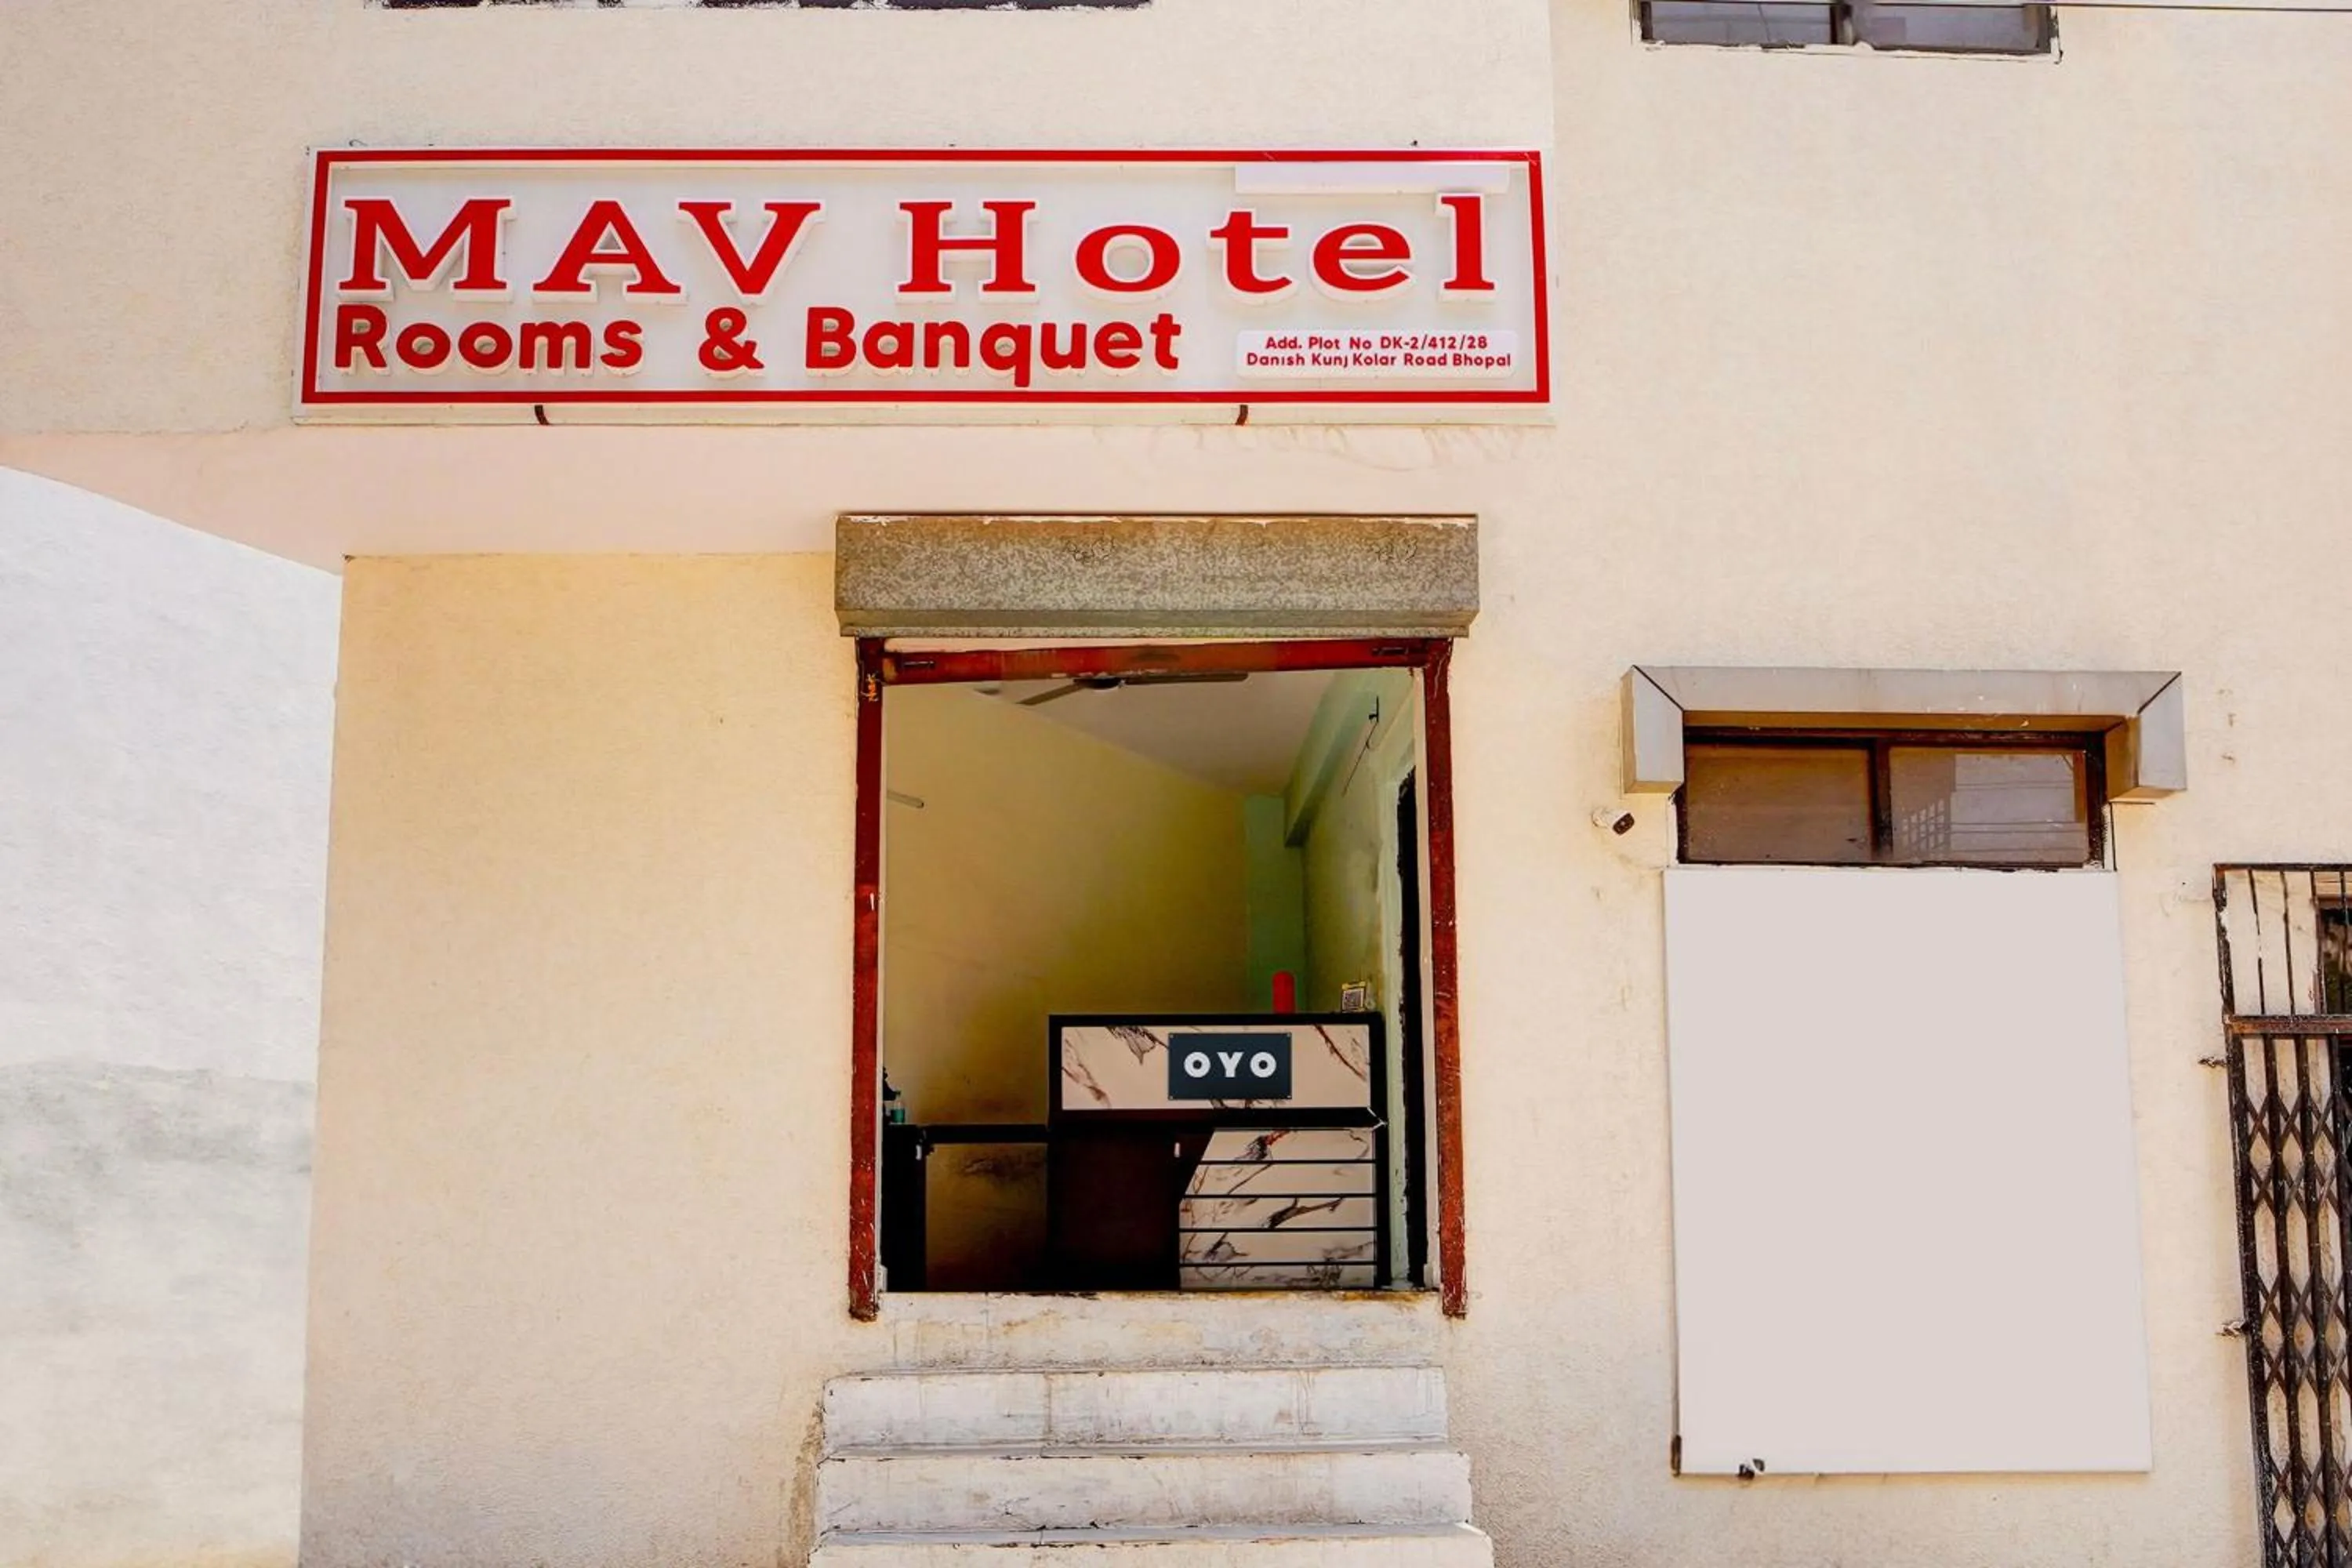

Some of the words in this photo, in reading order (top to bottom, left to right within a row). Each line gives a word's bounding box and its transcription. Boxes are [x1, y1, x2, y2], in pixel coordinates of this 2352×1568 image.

[338, 198, 822, 295] MAV
[898, 195, 1495, 294] Hotel
[334, 303, 644, 369] Rooms
[698, 307, 765, 371] &
[806, 307, 1181, 388] Banquet
[1265, 336, 1302, 350] Add.
[1308, 336, 1341, 350] Plot
[1349, 337, 1372, 350] No
[1380, 335, 1488, 350] DK-2/412/28
[1247, 353, 1305, 366] Danish
[1311, 354, 1348, 368] Kunj
[1352, 353, 1395, 366] Kolar
[1404, 353, 1448, 366] Road
[1452, 353, 1511, 368] Bhopal
[1184, 1051, 1277, 1078] OYO
